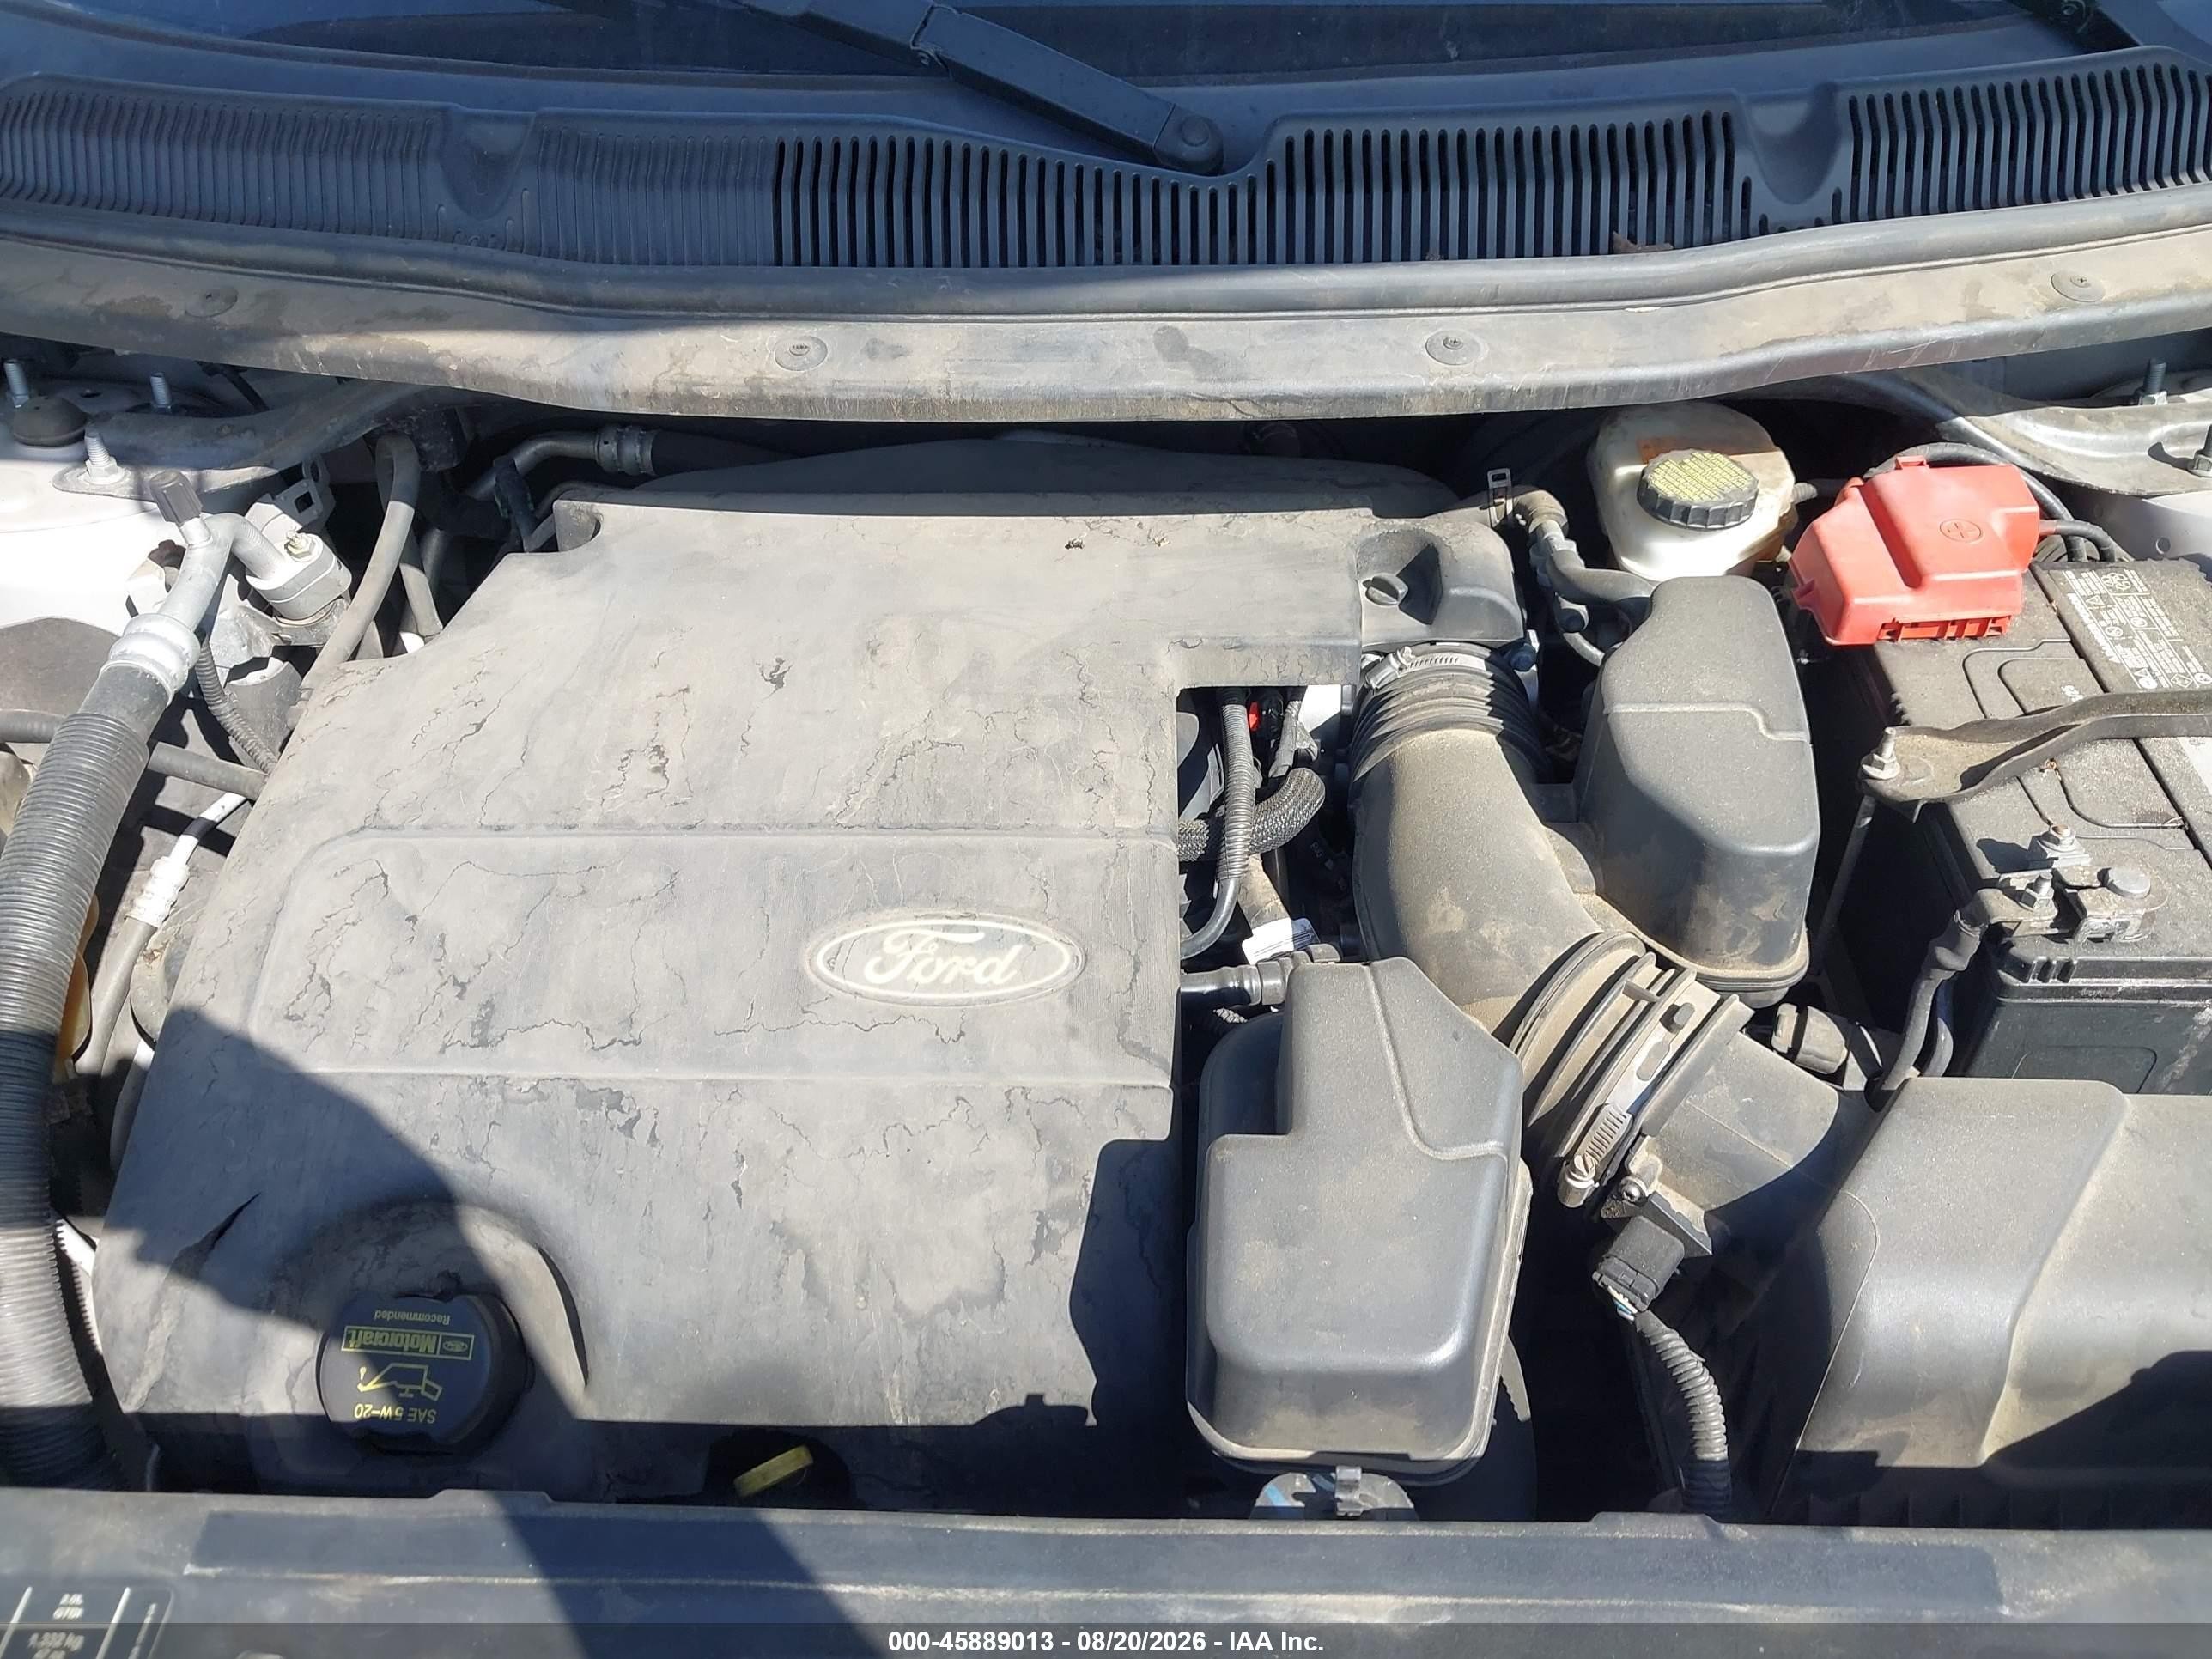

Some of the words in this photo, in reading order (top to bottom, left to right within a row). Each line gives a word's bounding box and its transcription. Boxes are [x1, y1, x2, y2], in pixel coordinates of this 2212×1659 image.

[864, 929, 1024, 984] Ford
[374, 1310, 450, 1325] Recommended
[349, 1330, 437, 1353] Motorcraft
[407, 1407, 437, 1424] SAE
